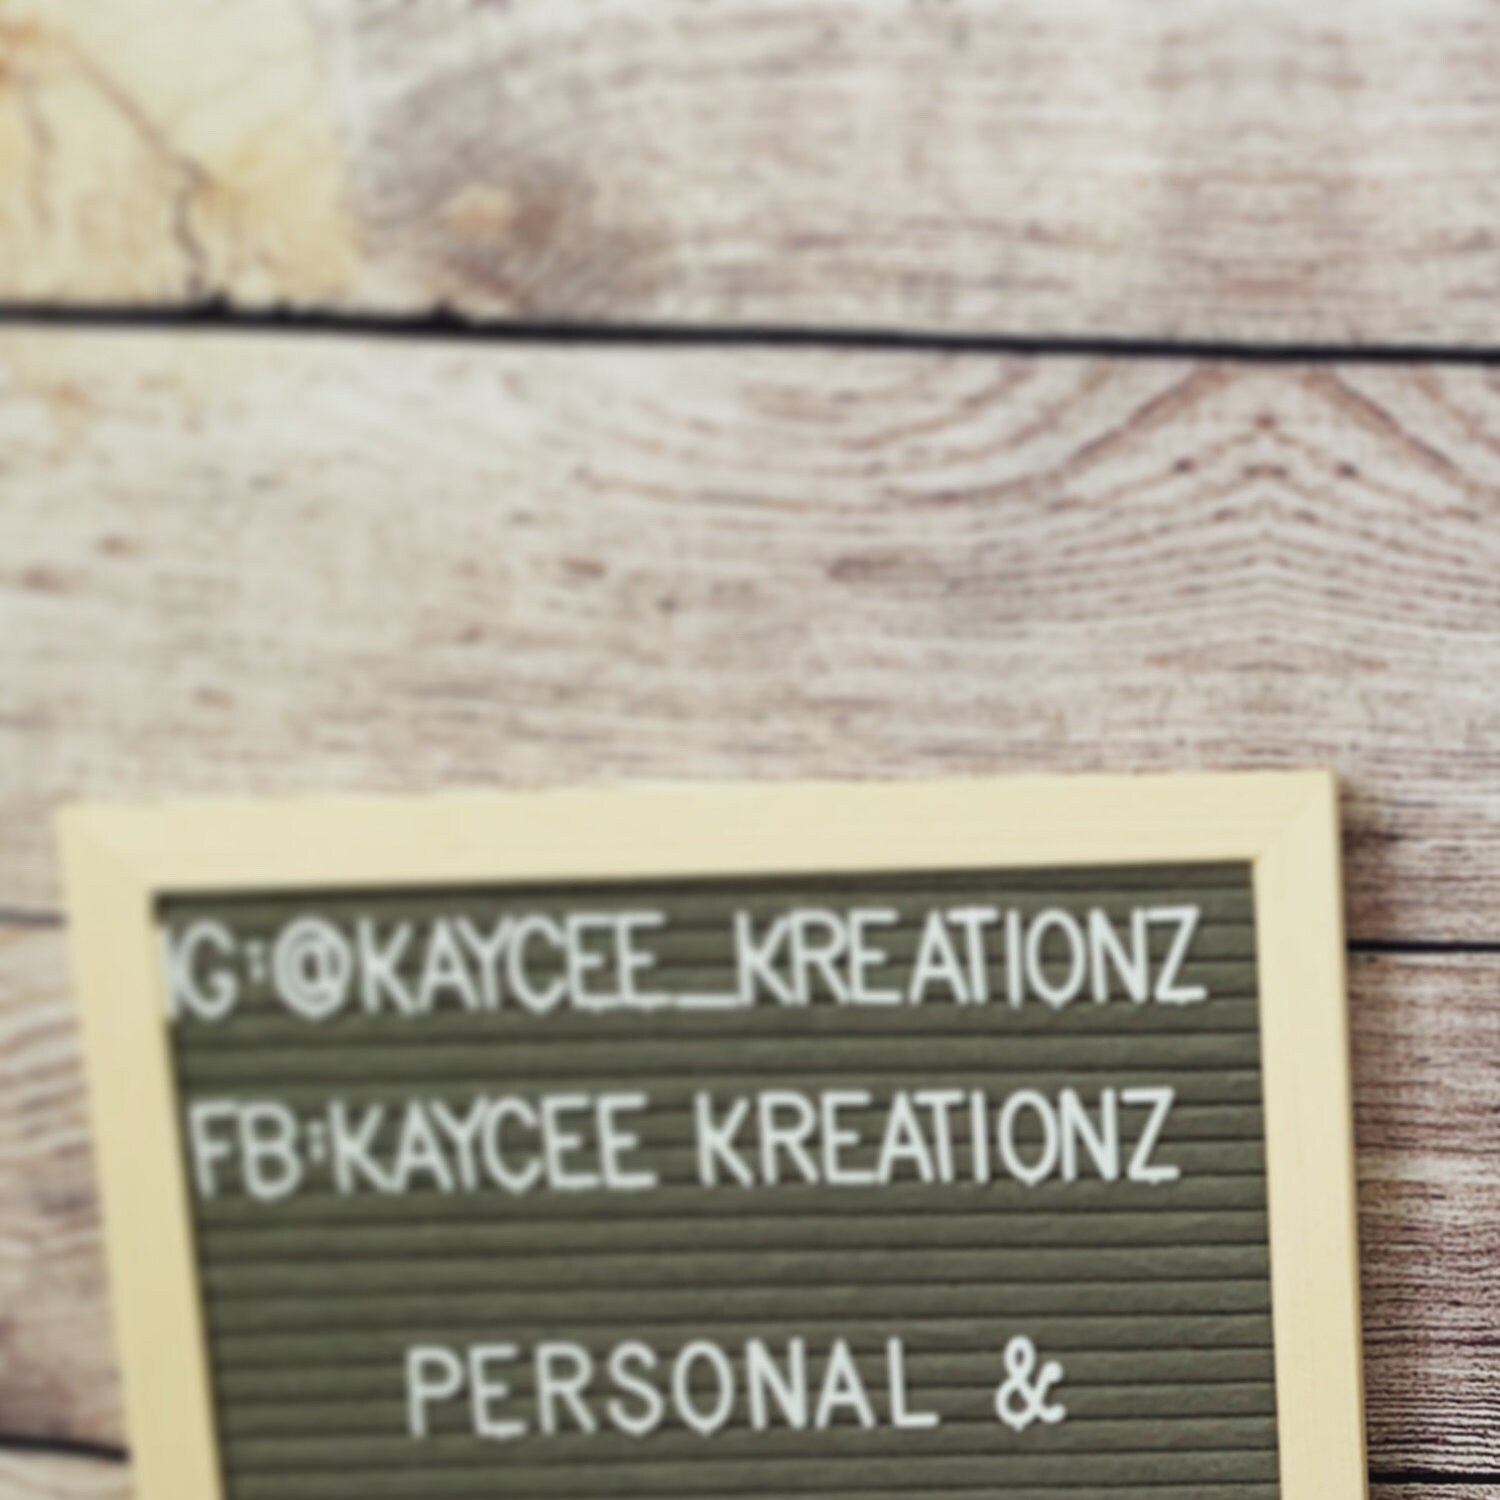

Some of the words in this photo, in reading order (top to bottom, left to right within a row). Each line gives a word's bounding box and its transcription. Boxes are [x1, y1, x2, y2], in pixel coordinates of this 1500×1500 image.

[189, 1093, 655, 1202] FB:KAYCEE
[694, 1086, 1181, 1187] KREATIONZ
[404, 1336, 939, 1438] PERSONAL
[994, 1335, 1066, 1431] &
